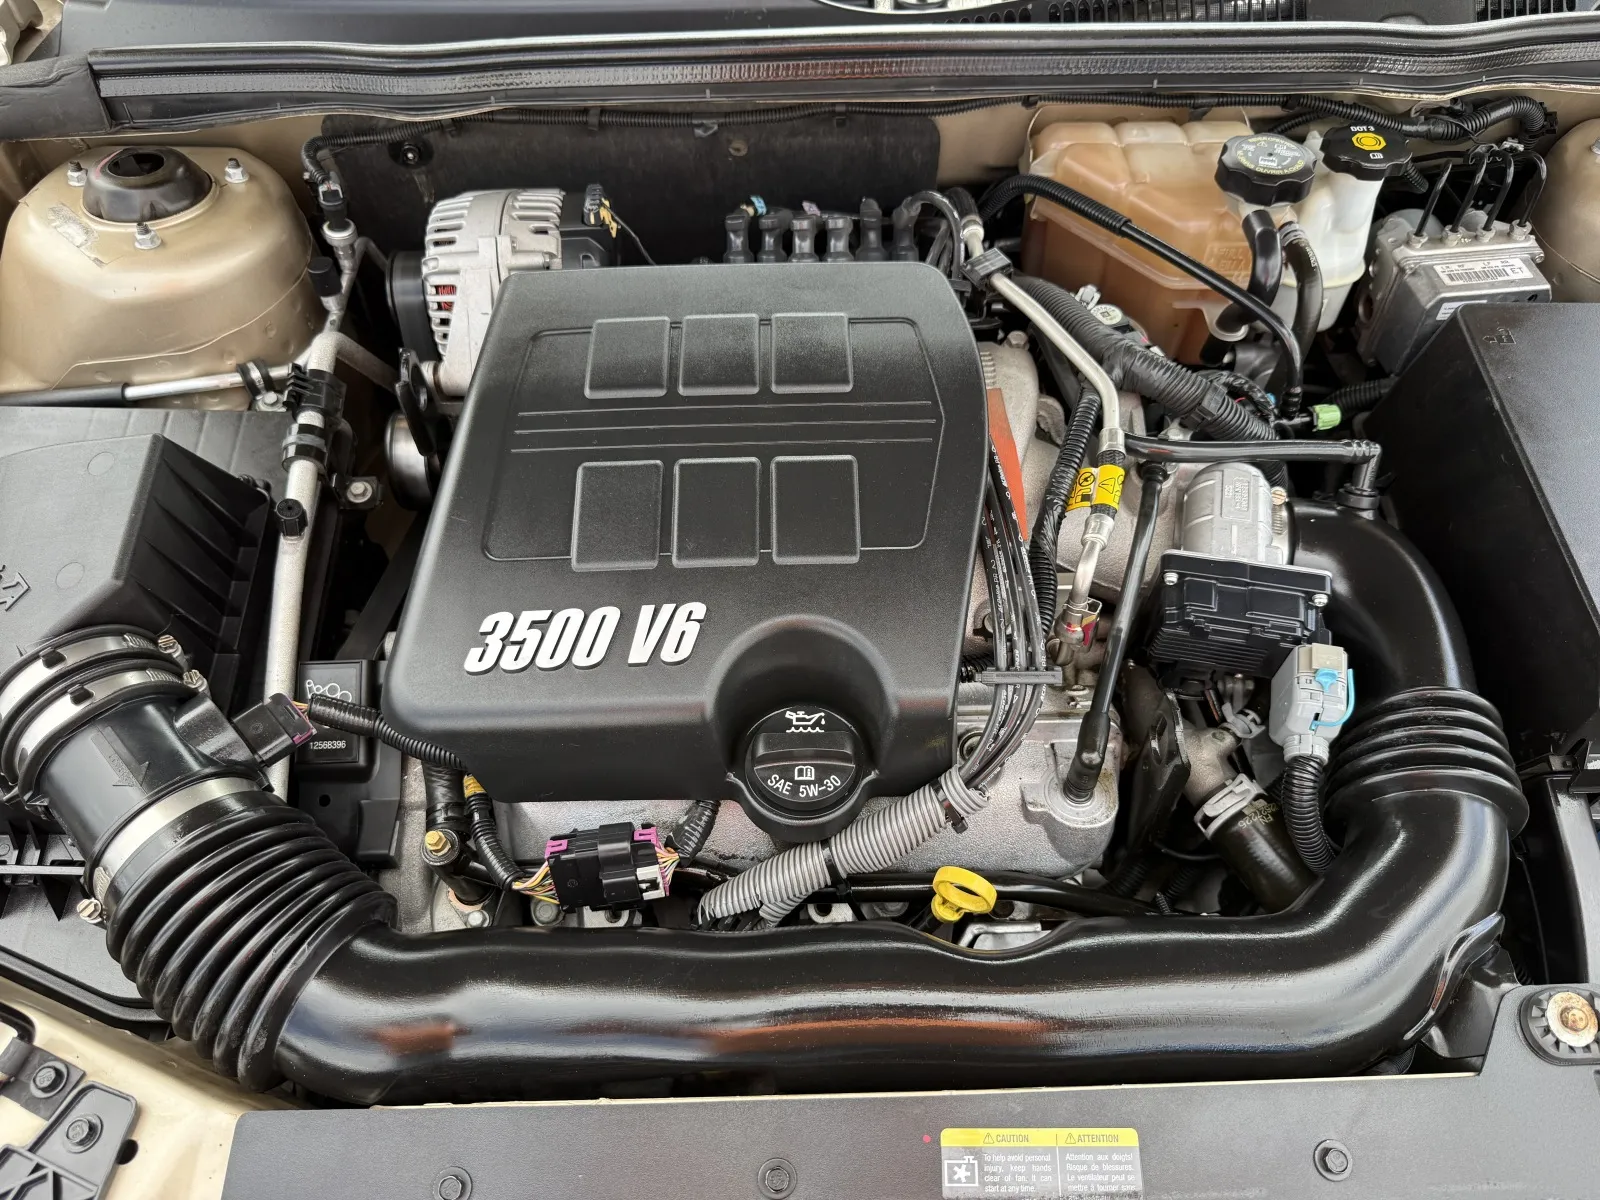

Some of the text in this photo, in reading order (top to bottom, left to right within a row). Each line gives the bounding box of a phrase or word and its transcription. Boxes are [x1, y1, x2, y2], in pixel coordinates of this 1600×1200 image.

[1510, 267, 1524, 275] ET
[463, 601, 708, 676] 3500 V6
[309, 740, 347, 750] 12568396
[767, 774, 841, 798] SAE 5W-30
[996, 1134, 1029, 1143] CAUTION
[1077, 1134, 1119, 1143] ATTENTION
[983, 1153, 1051, 1163] To help avoid personal
[1065, 1153, 1094, 1161] Attention
[1111, 1152, 1133, 1162] doigts!
[984, 1163, 1052, 1173] injury, keep hands
[1066, 1163, 1134, 1172] Risque de blessures.
[984, 1174, 1001, 1182] clear
[1004, 1174, 1011, 1182] of
[1015, 1174, 1028, 1182] fan.
[1067, 1173, 1076, 1181] Le
[1076, 1173, 1110, 1181] ventilateur
[1111, 1174, 1125, 1182] peut
[984, 1185, 1036, 1194] start at any time.
[1067, 1184, 1089, 1192] mettre
[1096, 1184, 1119, 1192] tourner
